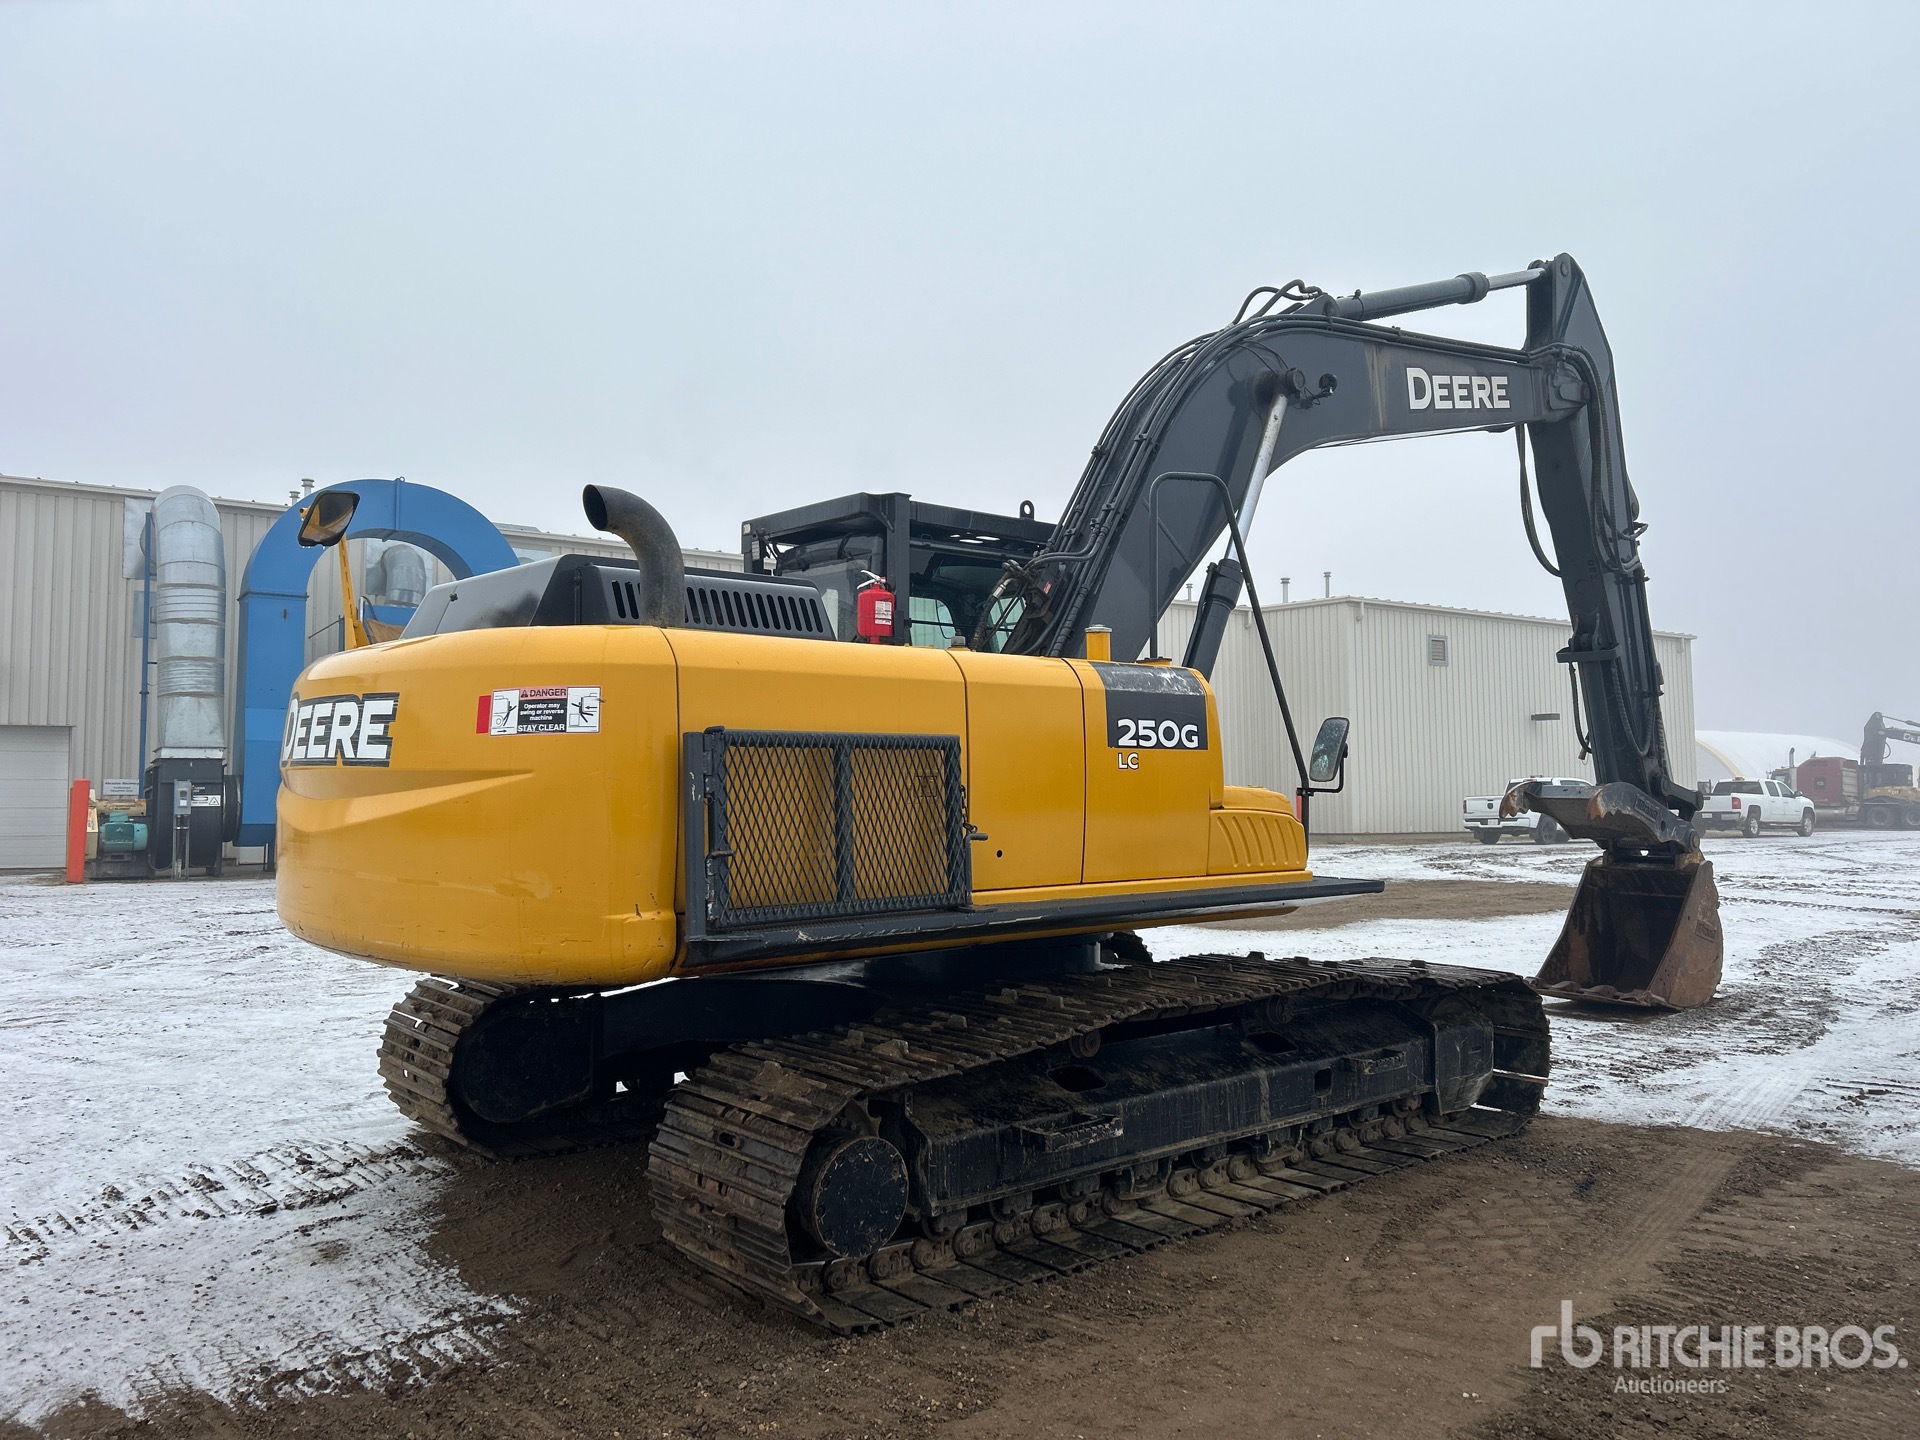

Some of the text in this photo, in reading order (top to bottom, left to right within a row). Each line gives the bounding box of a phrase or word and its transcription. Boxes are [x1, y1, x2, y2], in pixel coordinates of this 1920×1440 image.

[1406, 367, 1511, 410] DEERE
[529, 688, 567, 698] DANGER
[520, 709, 536, 717] swing
[282, 698, 394, 761] DEERE
[517, 723, 566, 733] STAY CLEAR
[1117, 718, 1199, 748] 250G
[1118, 752, 1138, 769] LC
